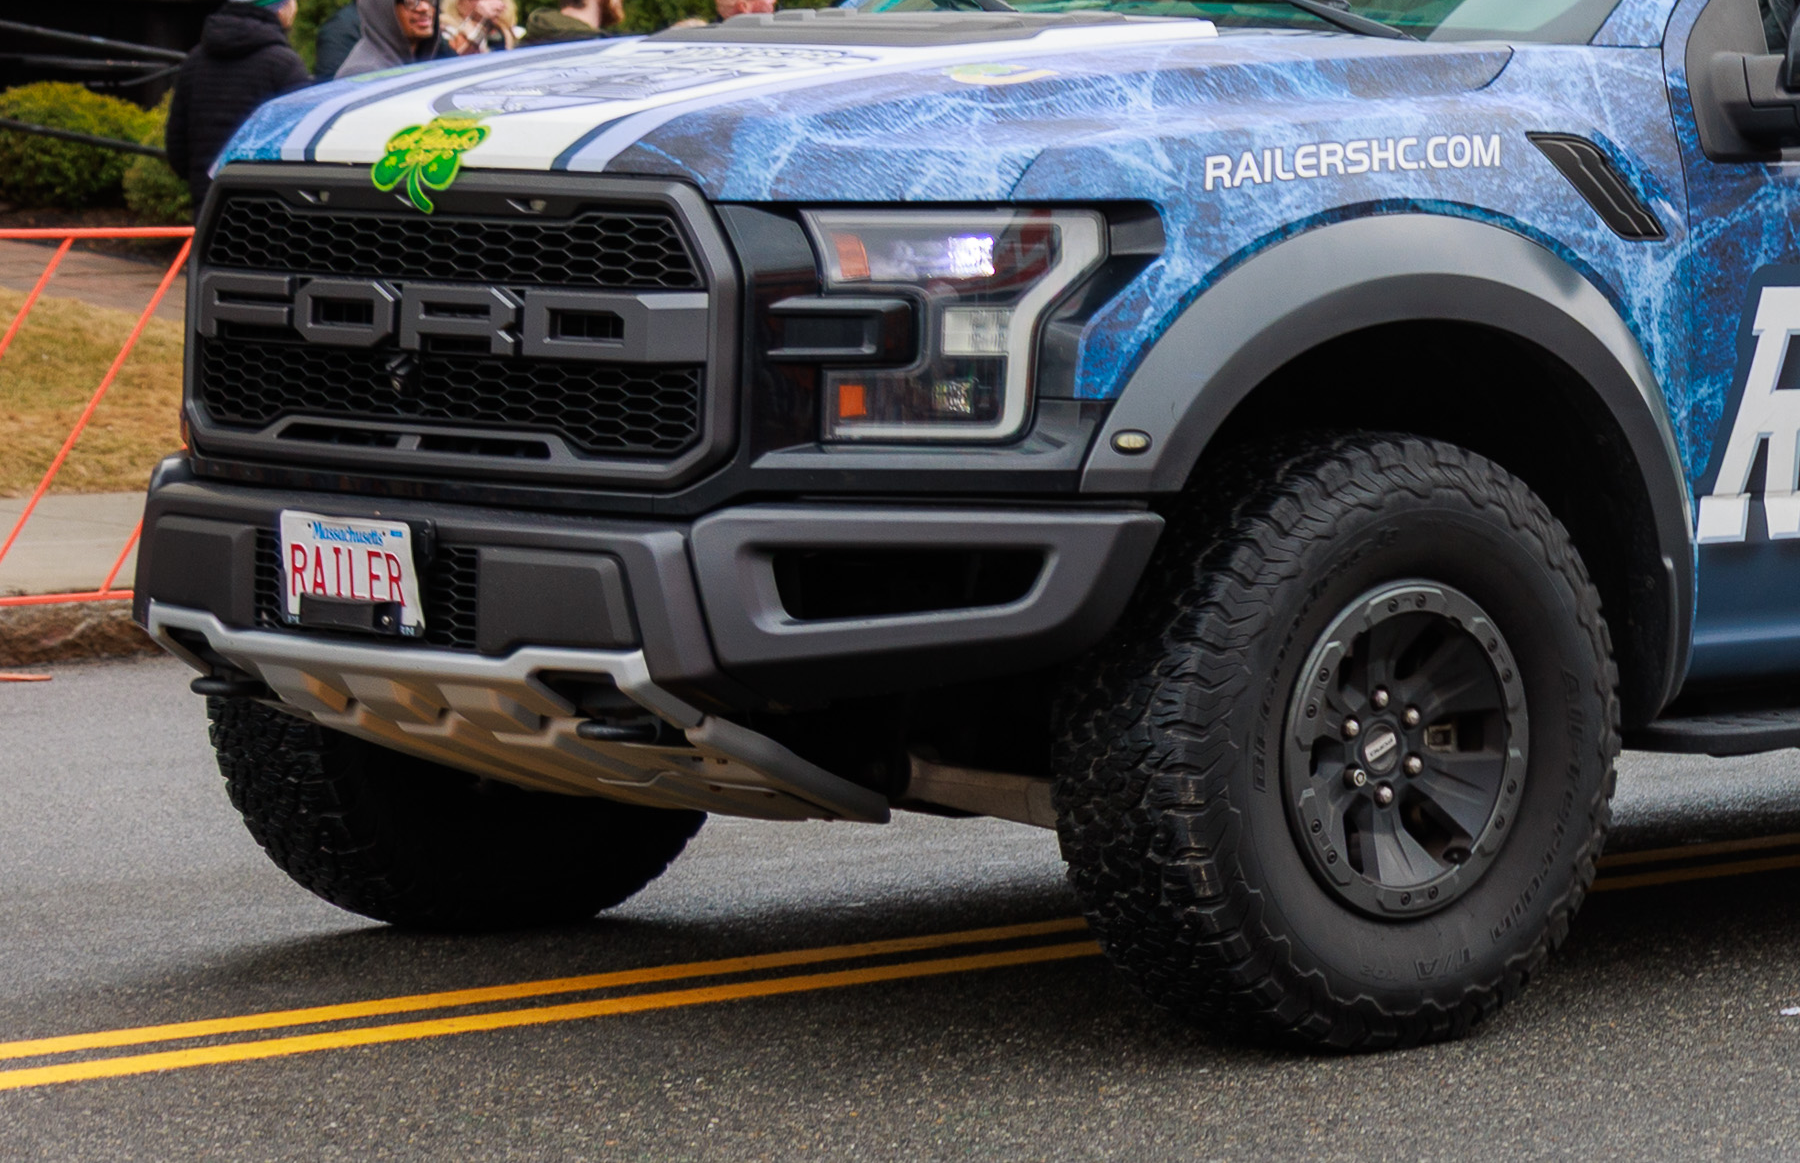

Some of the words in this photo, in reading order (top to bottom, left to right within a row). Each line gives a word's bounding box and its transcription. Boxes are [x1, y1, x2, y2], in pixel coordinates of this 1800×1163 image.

[1205, 134, 1500, 191] RAILERSHC.COM
[197, 271, 690, 364] FORD
[312, 521, 384, 546] Massachusetts
[290, 542, 407, 608] RAILER
